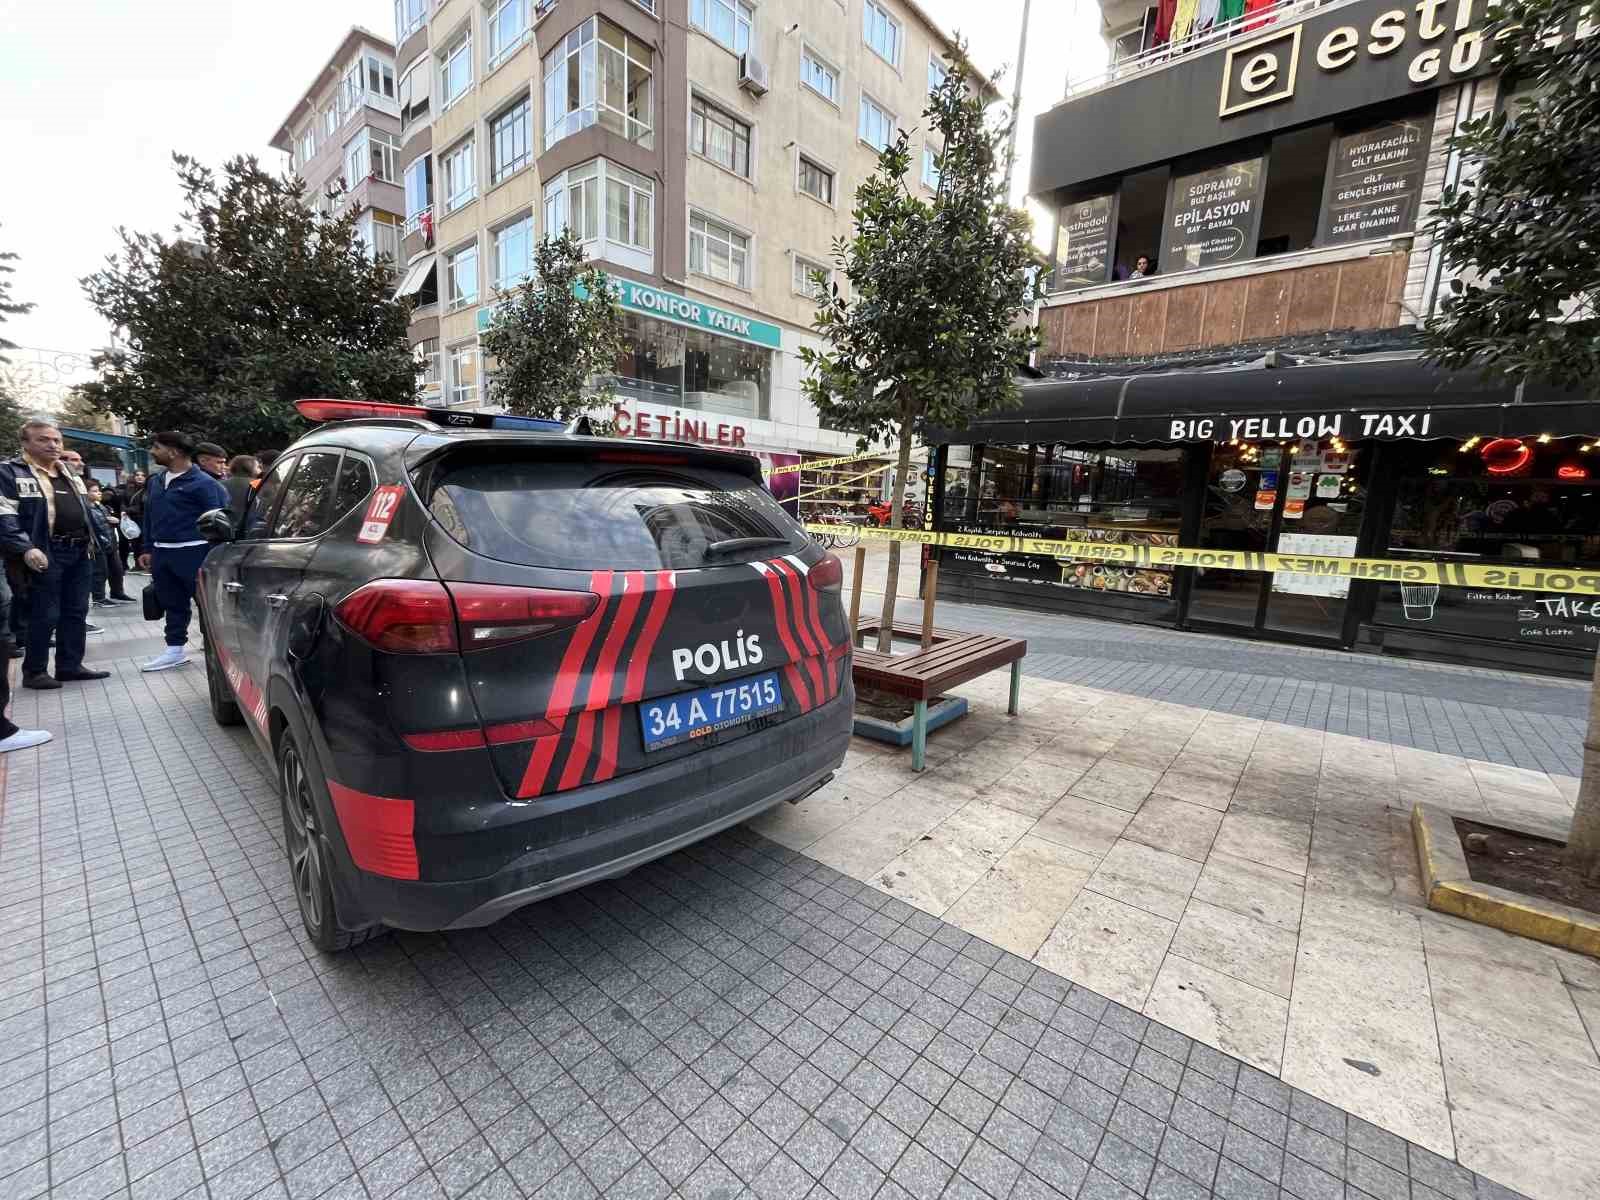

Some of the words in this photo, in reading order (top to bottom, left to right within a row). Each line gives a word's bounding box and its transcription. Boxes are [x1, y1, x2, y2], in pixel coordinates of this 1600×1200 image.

[1373, 148, 1409, 163] BAKIMI
[1189, 175, 1242, 197] SOPRANO
[1174, 200, 1251, 227] EPİLASYON
[1338, 211, 1361, 223] LEKE
[1332, 223, 1357, 234] SKAR
[630, 286, 700, 322] KONFOR
[706, 308, 751, 337] YATAK
[1170, 419, 1214, 440] BIG
[1230, 414, 1342, 438] YELLOW
[1360, 413, 1431, 437] TAXI
[371, 492, 398, 519] 112
[925, 476, 936, 531] YELLOW
[672, 629, 763, 680] POLİS
[649, 702, 682, 736] 34
[688, 697, 708, 725] A
[711, 678, 776, 718] 77515
[689, 725, 712, 739] GOLD
